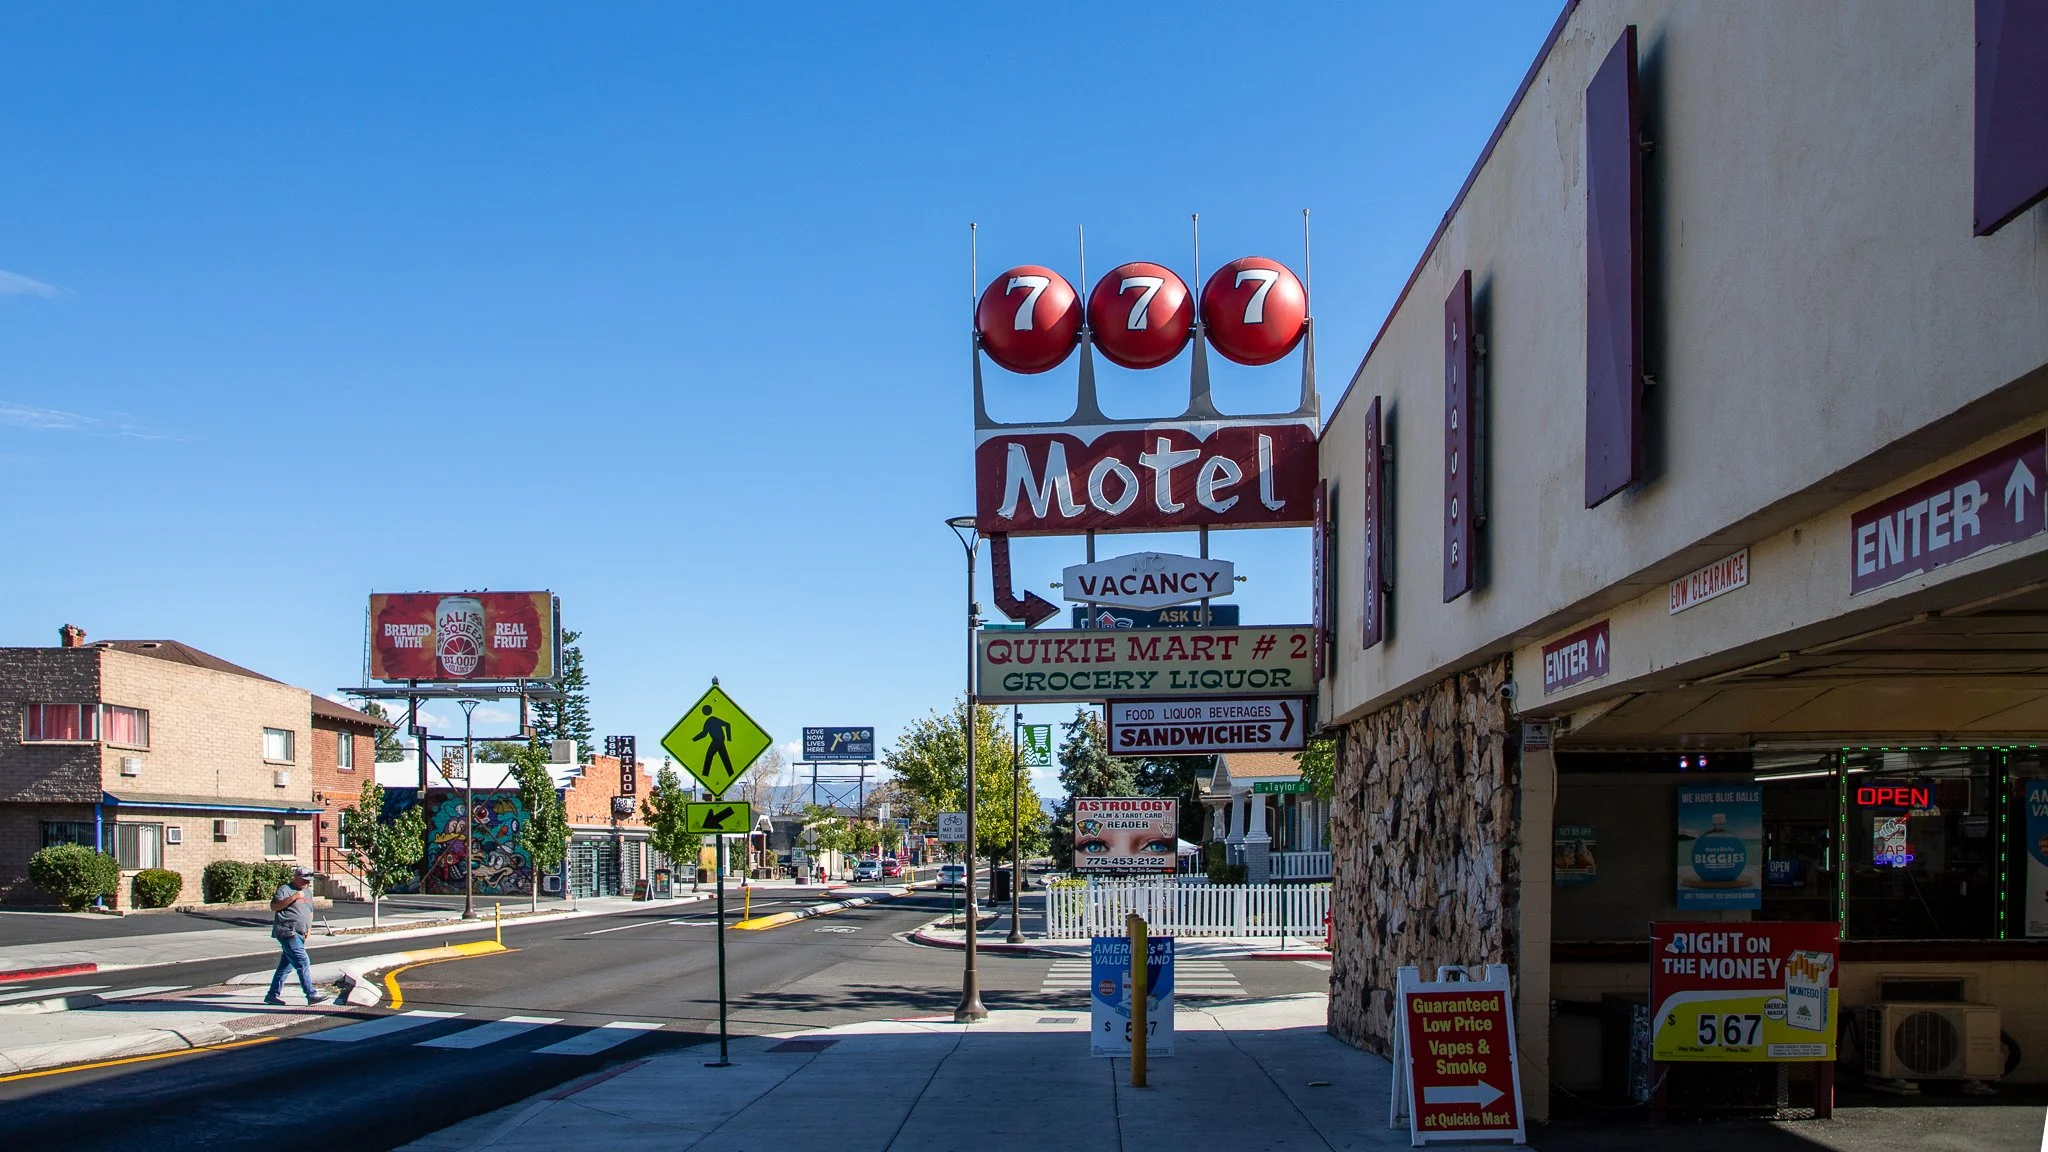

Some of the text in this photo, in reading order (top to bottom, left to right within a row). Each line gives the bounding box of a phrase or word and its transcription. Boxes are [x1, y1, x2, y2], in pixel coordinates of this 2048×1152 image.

[1005, 268, 1281, 331] 7 7 7
[1451, 321, 1459, 564] LIQUOR
[997, 433, 1286, 520] Motel
[1857, 479, 1983, 577] ENTER
[1078, 572, 1220, 597] VACANCY
[1671, 554, 1745, 610] LOW CLEARANCE
[439, 611, 467, 628] CALI
[1158, 610, 1190, 623] ASK
[384, 623, 432, 637] BREWED
[445, 624, 483, 648] SQUEEZE
[495, 623, 527, 636] REAL
[393, 636, 423, 648] WITH
[493, 635, 528, 649] FRUIT
[986, 634, 1307, 665] QUIKIE MART # 2
[444, 656, 476, 667] BLOOD
[1545, 639, 1588, 684] ENTER
[1003, 668, 1292, 692] GROCERY LIQUOR
[1125, 706, 1272, 721] FOOD LIQUOR BEVERAGES
[1119, 724, 1272, 748] SANDWICHES
[622, 737, 633, 791] TATTOO
[1269, 782, 1296, 793] Taylor
[1682, 792, 1759, 804] WE HAVE BLUE BALLS
[1857, 786, 1929, 807] OPEN
[1078, 801, 1173, 811] ASTROLOGY
[1086, 857, 1165, 865] 775-453-2122
[1694, 853, 1745, 864] BIGGIES
[1770, 861, 1790, 872] OPEN
[1875, 854, 1914, 865] SHOP
[1157, 941, 1172, 954] #1
[1673, 932, 1771, 954] RIGHT ON
[1095, 956, 1129, 965] VALUE
[1661, 957, 1781, 979] THE MONEY
[1789, 985, 1819, 999] MONTEGO
[1413, 996, 1499, 1014] Guaranteed
[1104, 1021, 1111, 1032] $
[1423, 1016, 1493, 1032] Low Price
[1668, 1014, 1762, 1047] $ 5.67
[1428, 1039, 1490, 1059] Vapes &
[1436, 1059, 1487, 1075] Smoke
[1425, 1112, 1510, 1128] at Quickie Mart
